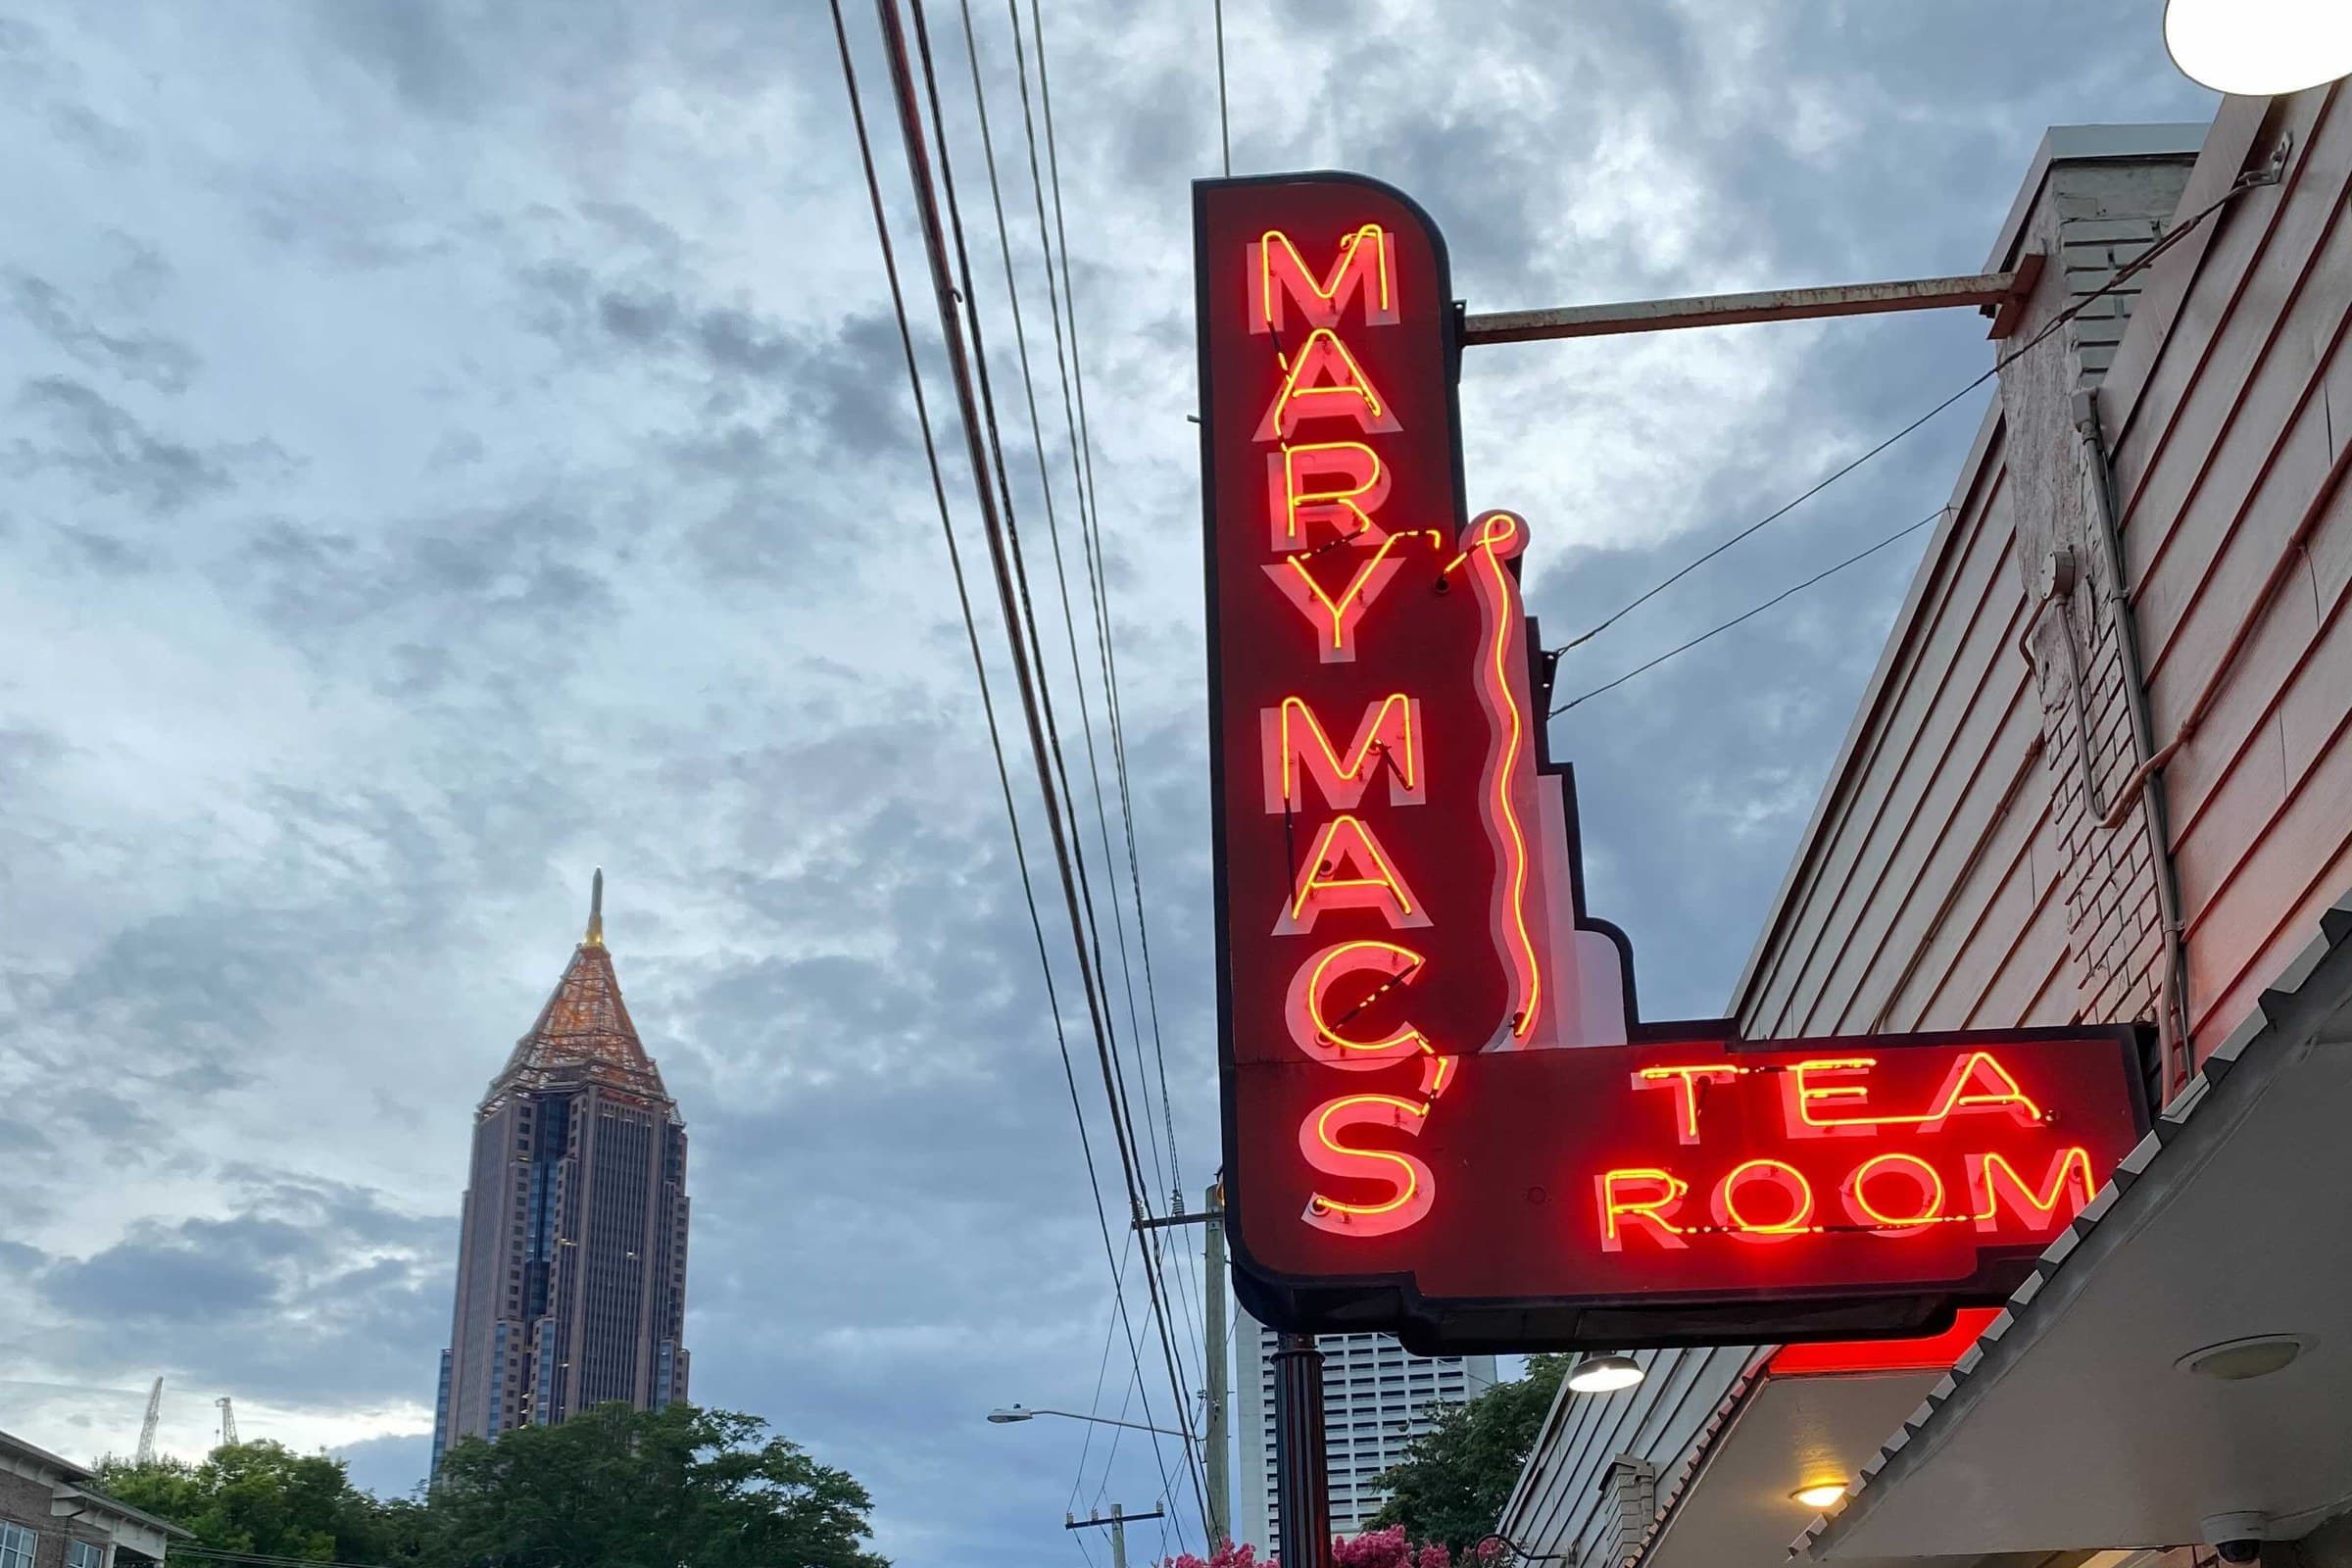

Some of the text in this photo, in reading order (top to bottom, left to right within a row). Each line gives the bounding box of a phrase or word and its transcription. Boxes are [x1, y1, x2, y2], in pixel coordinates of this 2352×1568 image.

[1246, 223, 1459, 1238] MARY MAC'S
[1631, 1052, 2046, 1146] TEA
[1593, 1147, 2095, 1252] ROOM
